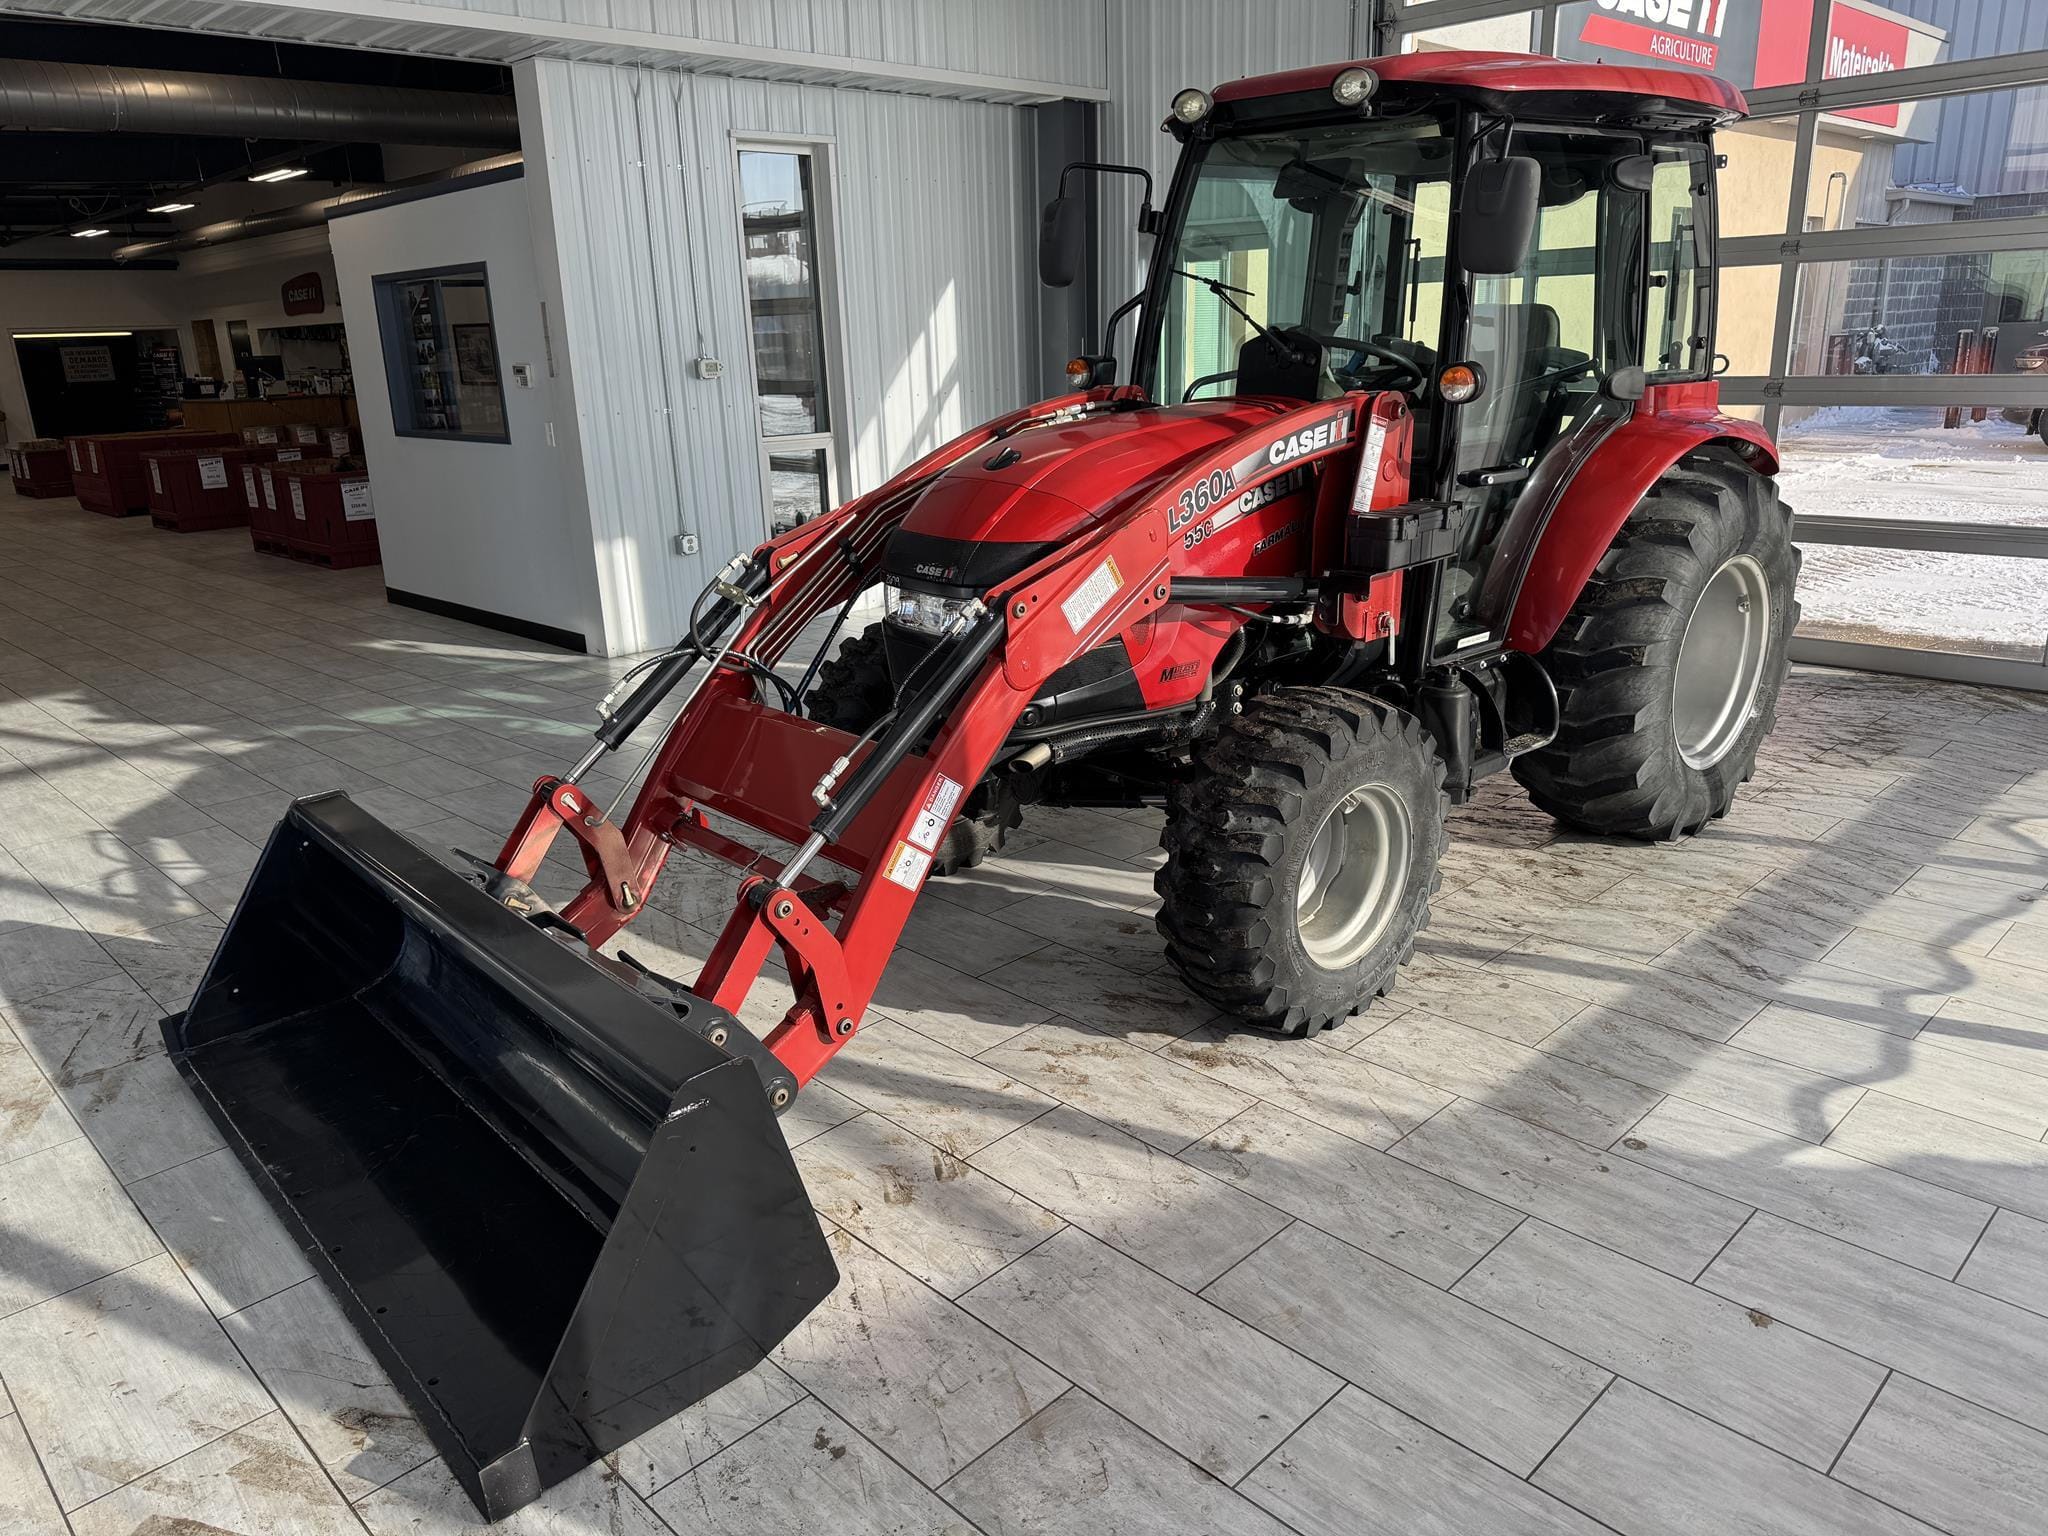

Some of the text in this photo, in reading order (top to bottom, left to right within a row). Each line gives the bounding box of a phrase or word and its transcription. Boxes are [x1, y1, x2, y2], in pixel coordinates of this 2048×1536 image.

[1596, 0, 1693, 29] ASE
[1650, 34, 1713, 65] AGRICULTURE
[1269, 424, 1328, 464] CASE
[1168, 468, 1236, 534] L360A
[1239, 476, 1288, 513] CASE
[1184, 518, 1213, 550] 55C
[916, 563, 943, 577] CASE
